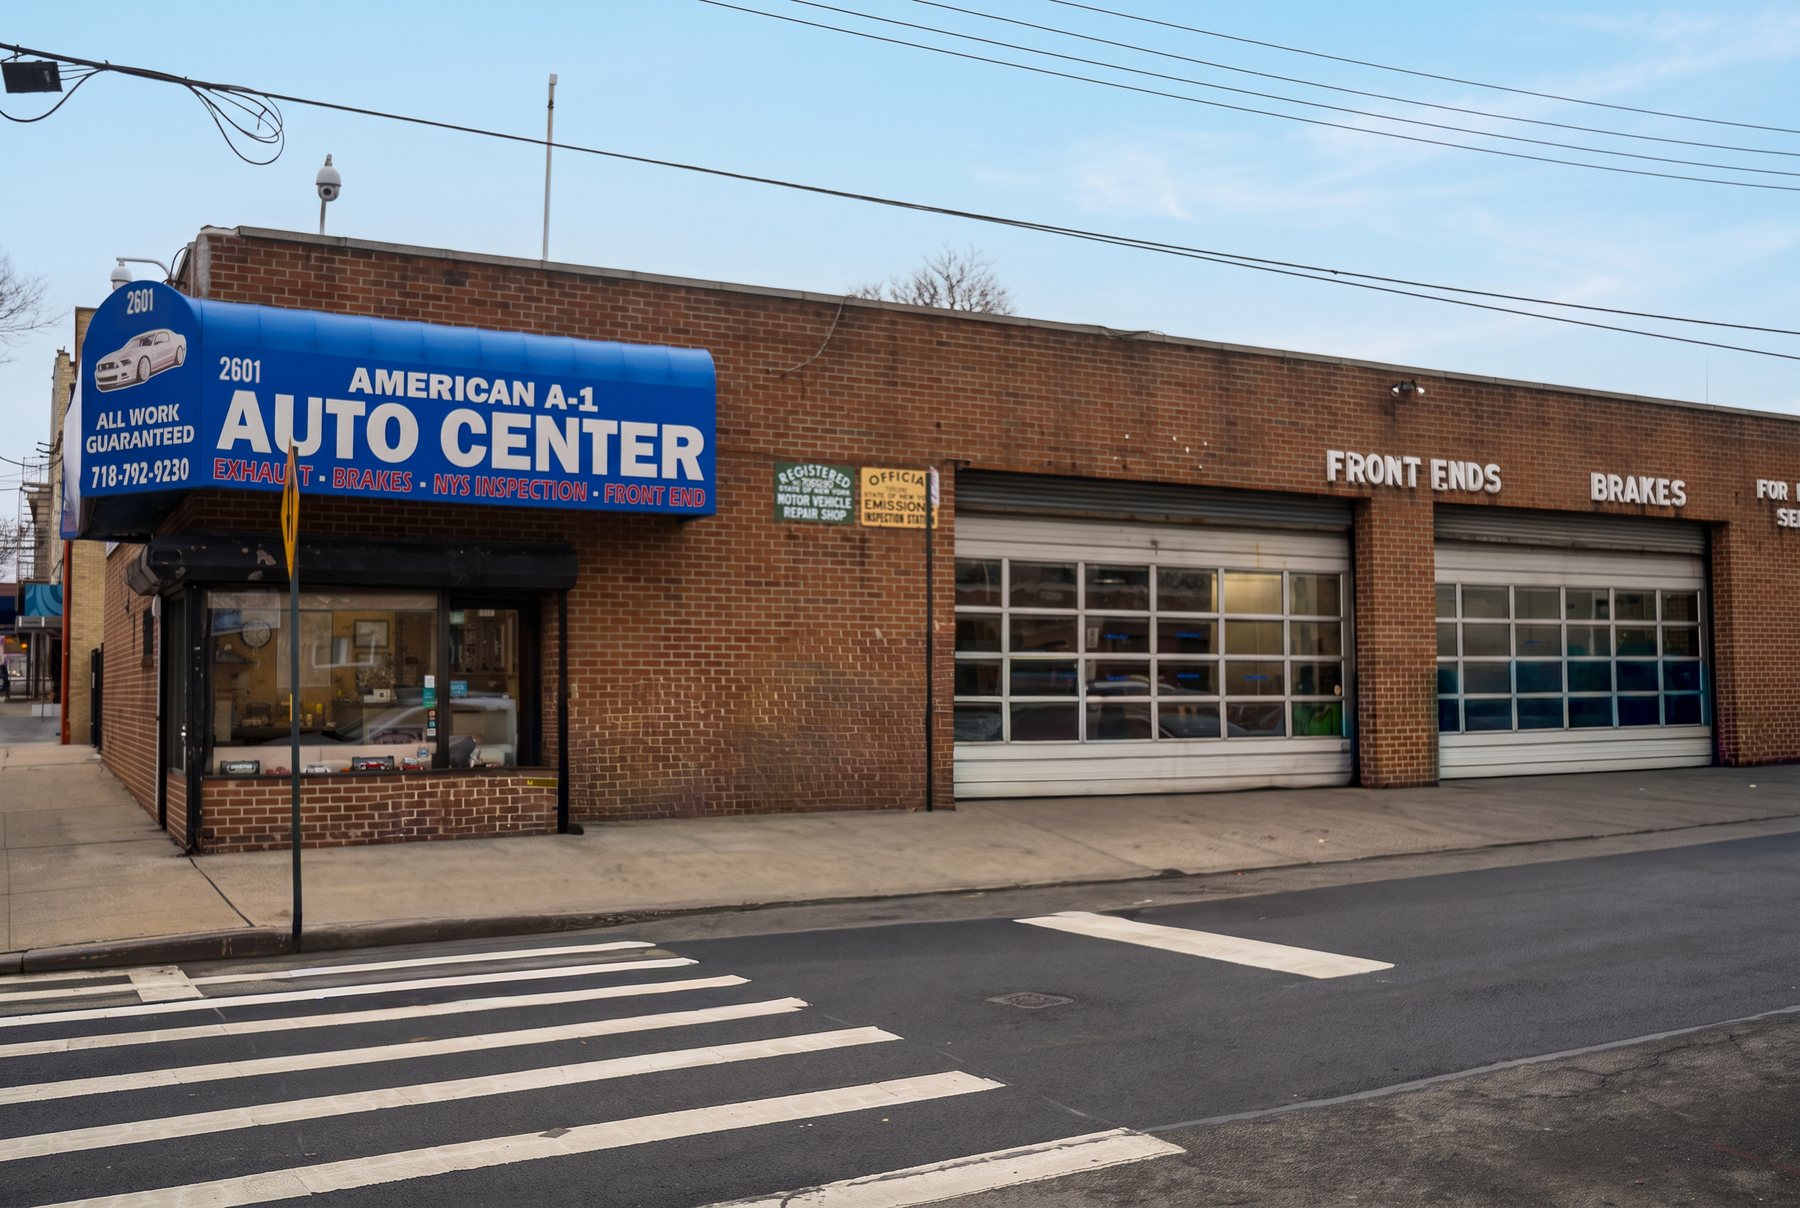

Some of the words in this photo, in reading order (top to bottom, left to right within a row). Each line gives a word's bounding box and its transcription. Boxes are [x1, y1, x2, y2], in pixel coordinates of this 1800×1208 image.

[127, 288, 153, 315] 2601
[219, 356, 261, 383] 2601
[348, 367, 535, 408] AMERICAN
[544, 384, 599, 412] A-1
[96, 407, 126, 430] ALL
[129, 403, 180, 427] WORK
[86, 425, 195, 454] GUARANTEED
[216, 389, 419, 463] AUTO
[440, 408, 705, 481] CENTER
[91, 457, 189, 490] 718-792-9230
[213, 457, 313, 487] EXHAUT
[332, 467, 413, 493] BRAKES
[433, 473, 470, 496] NYS
[475, 476, 587, 502] INSPECTION
[604, 483, 664, 506] FRONT
[669, 486, 706, 508] END
[778, 464, 851, 489] REGISTERED
[869, 471, 924, 487] OFFICIA
[1326, 449, 1421, 488] FRONT
[1430, 458, 1502, 494] ENDS
[777, 493, 810, 507] MOTOR
[812, 495, 852, 509] VEHICLE
[1590, 471, 1687, 507] BRAKES
[1756, 479, 1788, 500] FOR
[783, 506, 818, 519] REPAIR
[820, 508, 847, 521] SHOP
[864, 499, 933, 513] EMISSION
[1777, 508, 1800, 528] SE
